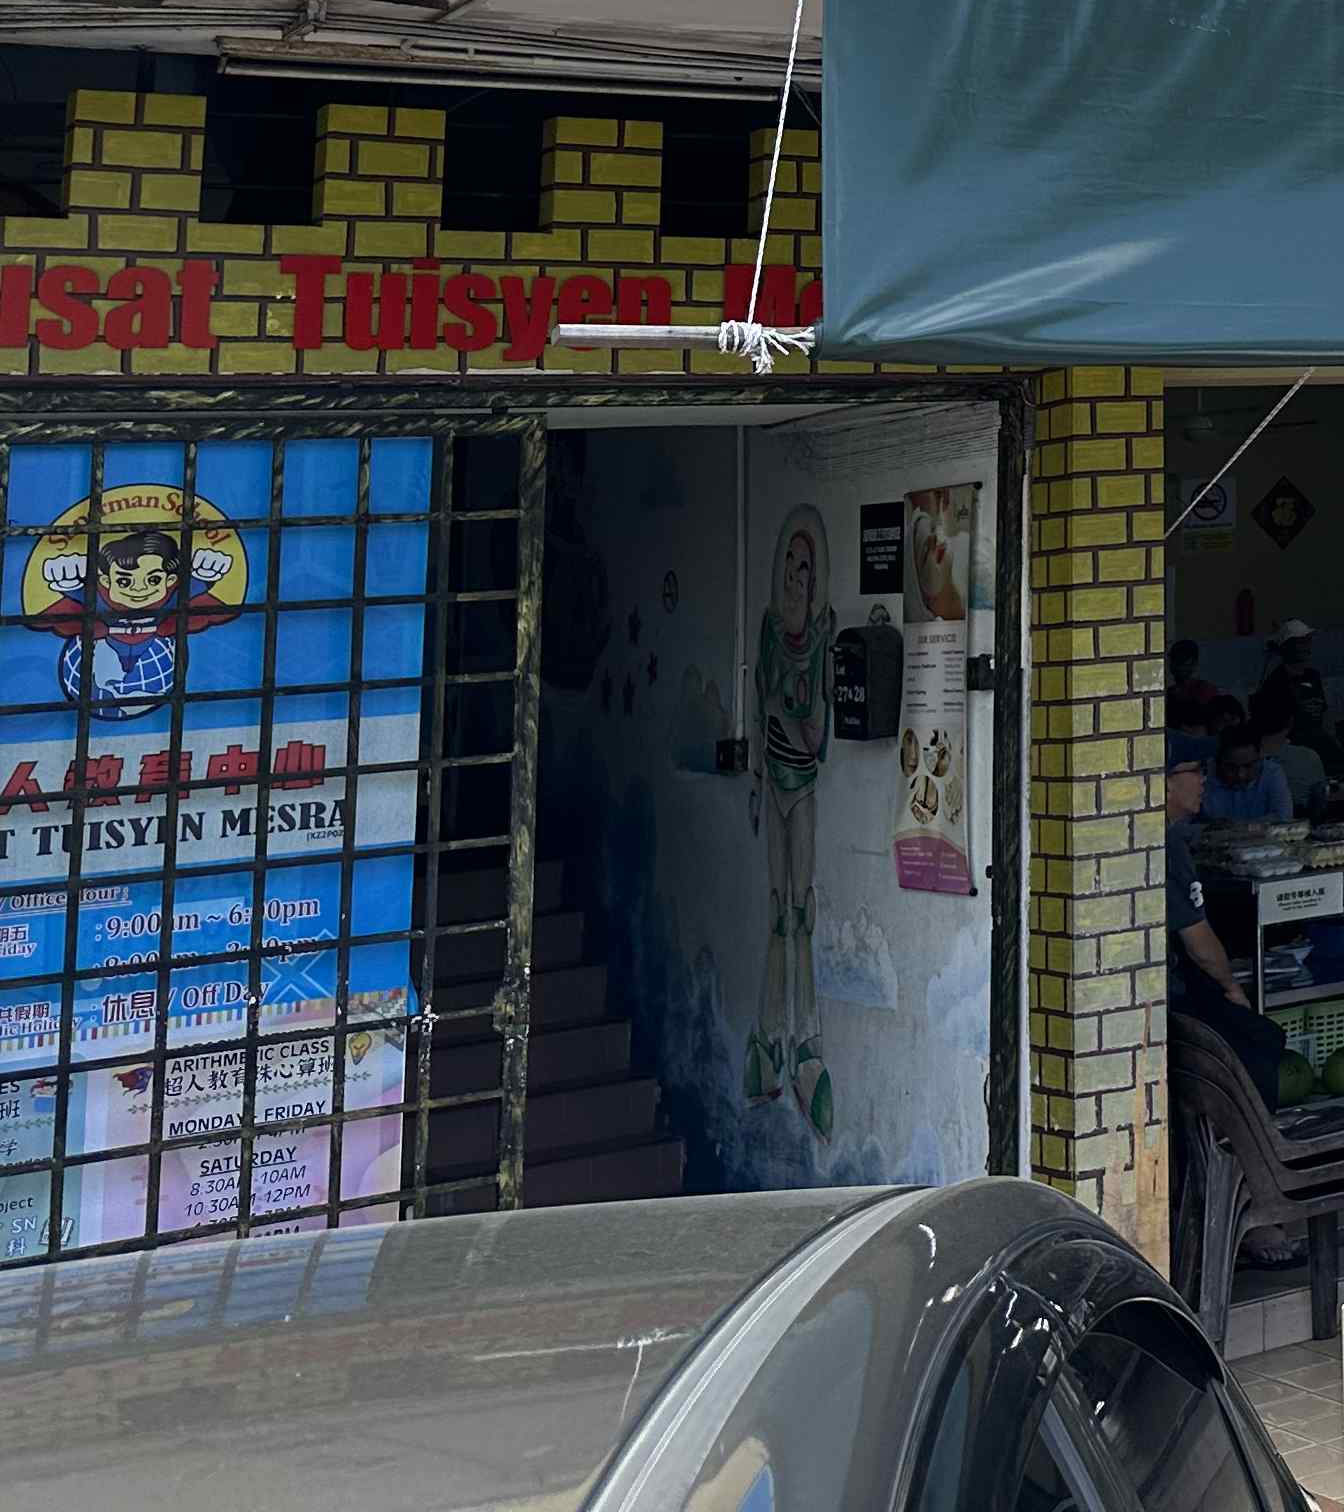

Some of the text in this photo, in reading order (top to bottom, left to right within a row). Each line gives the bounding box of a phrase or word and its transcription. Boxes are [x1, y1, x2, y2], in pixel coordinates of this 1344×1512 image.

[280, 254, 673, 362] Tuisyen
[47, 494, 160, 551] Sprman
[228, 898, 319, 926] 6:0pm
[182, 983, 217, 1008] Off
[279, 1040, 329, 1058] CLASS
[168, 1112, 245, 1137] MONDAY
[264, 1100, 327, 1121] FRIDAY
